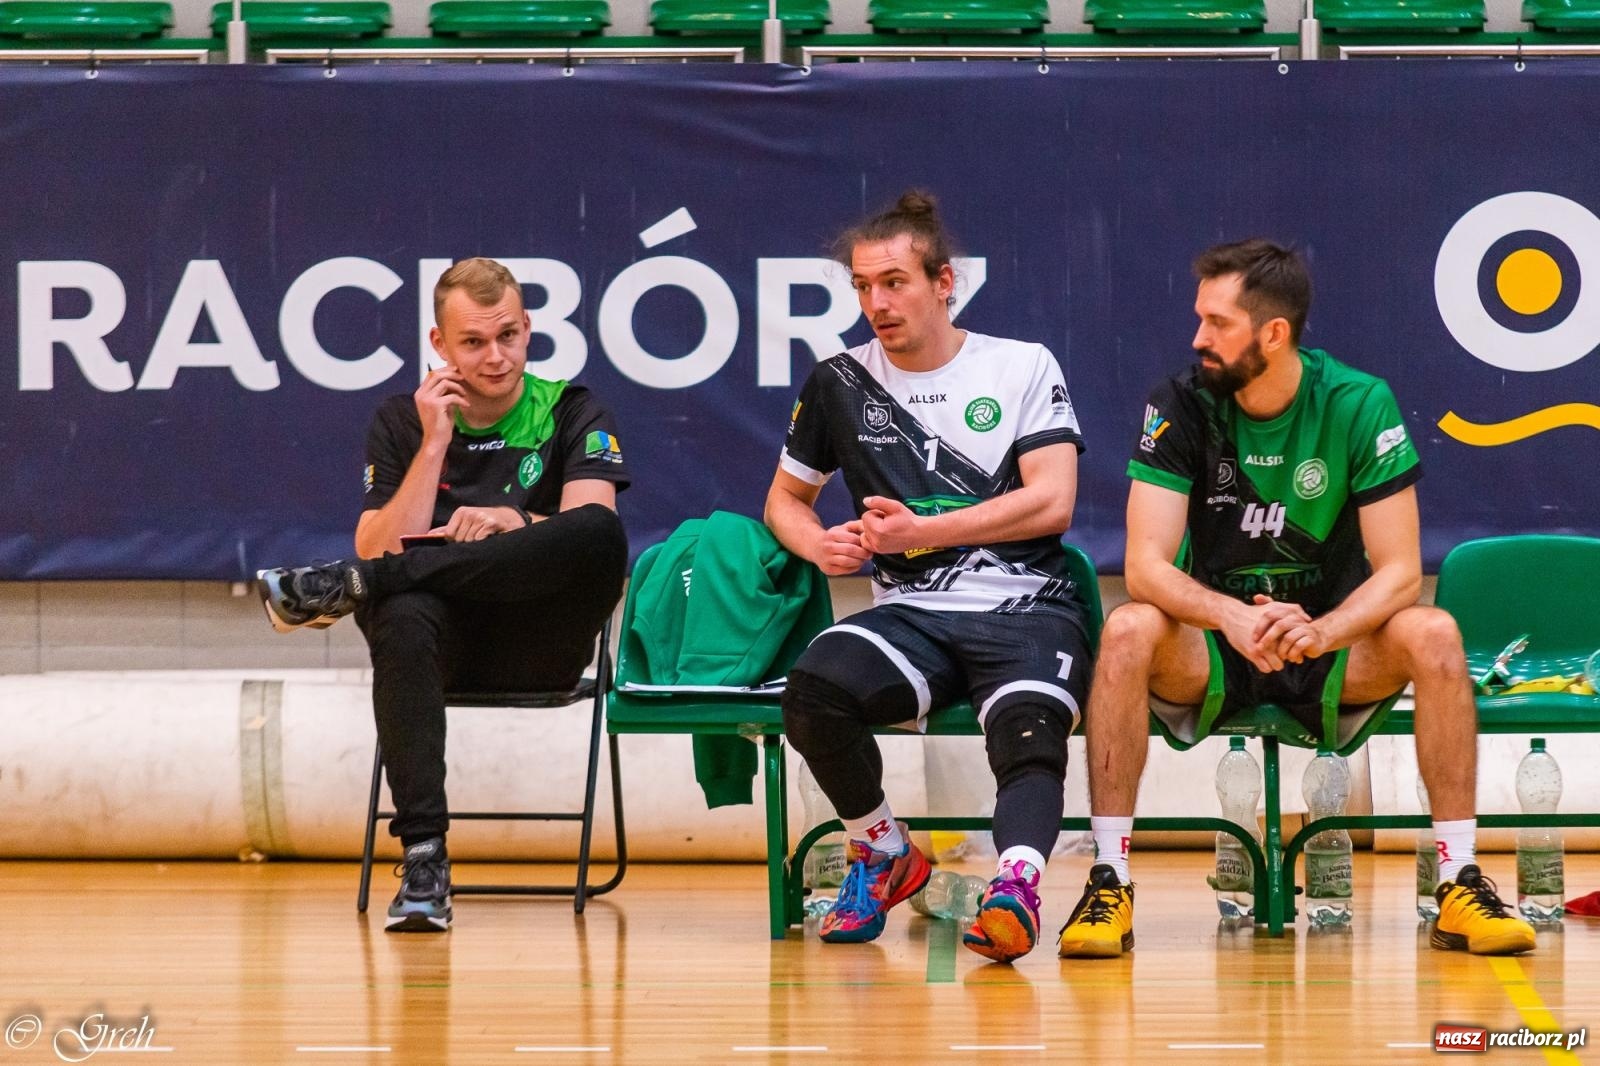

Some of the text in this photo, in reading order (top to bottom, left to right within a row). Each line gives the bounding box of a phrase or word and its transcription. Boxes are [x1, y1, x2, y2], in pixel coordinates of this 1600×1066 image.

[908, 393, 947, 404] ALLSIX
[857, 434, 898, 444] RACIBÓRZ
[923, 437, 940, 472] 1
[1244, 454, 1285, 467] ALLSIX
[1240, 501, 1287, 539] 44
[1056, 651, 1074, 681] 1
[866, 819, 890, 842] R
